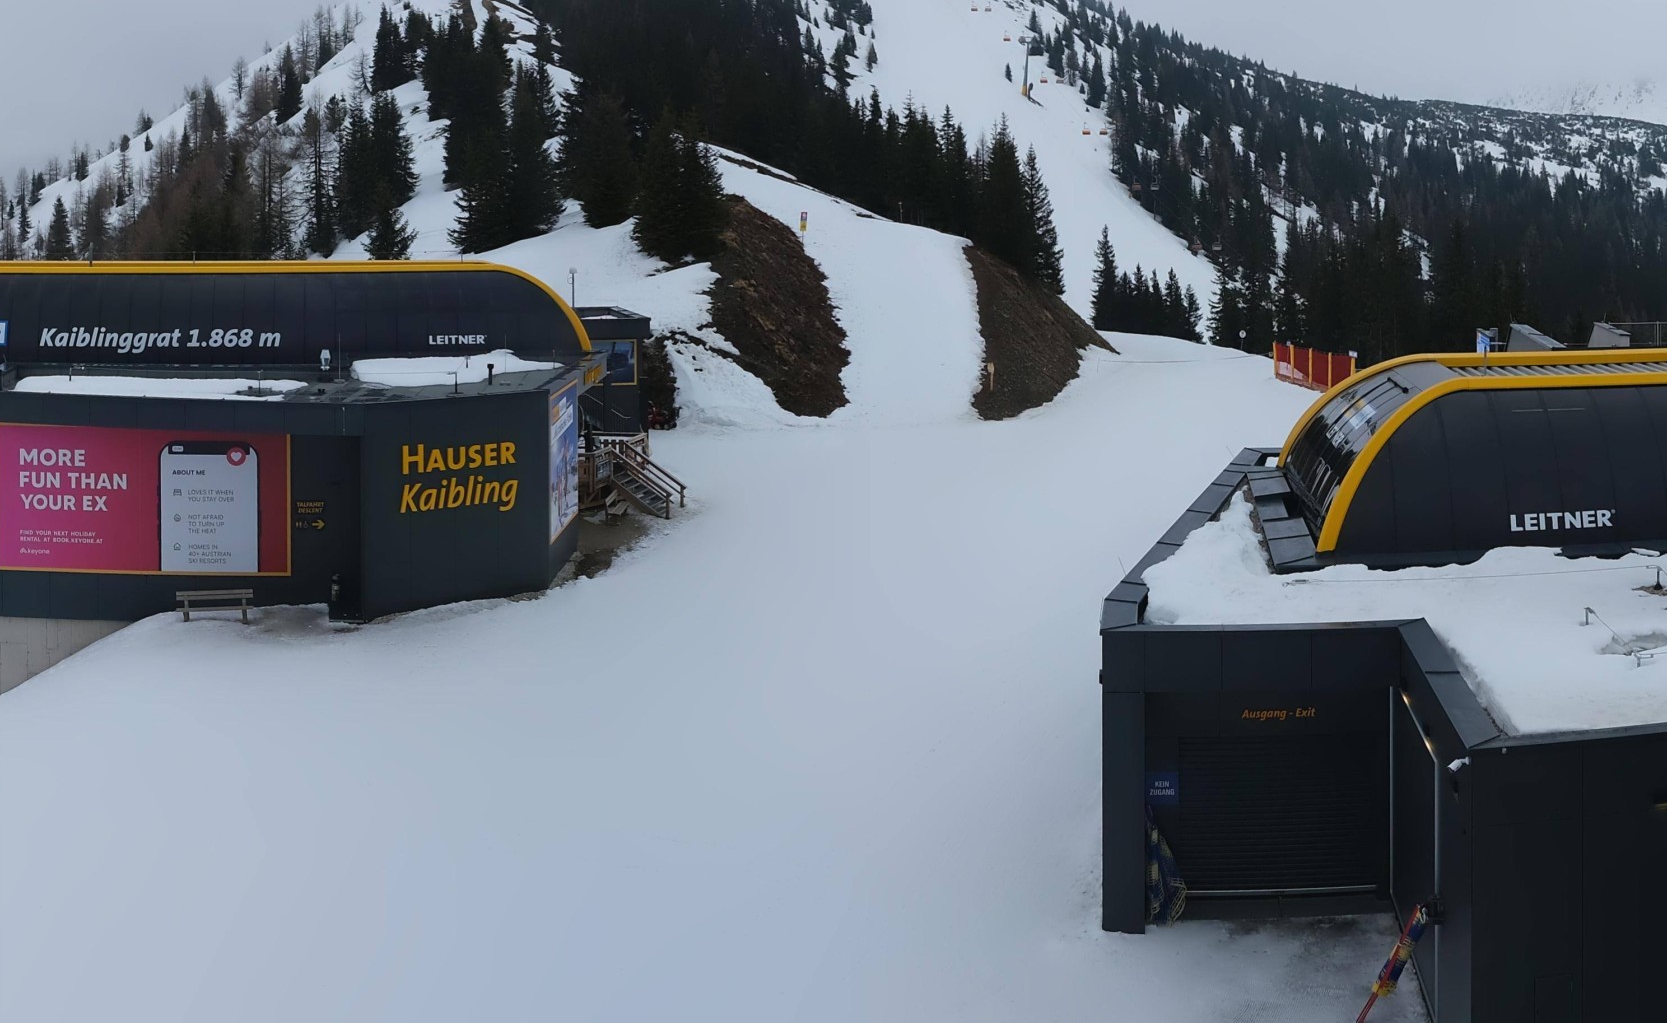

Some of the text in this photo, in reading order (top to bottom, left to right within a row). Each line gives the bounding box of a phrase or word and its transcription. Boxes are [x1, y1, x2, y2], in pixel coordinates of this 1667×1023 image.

[39, 326, 281, 354] Kaiblinggrat 1.868 m
[428, 334, 486, 345] LEITNER
[19, 448, 86, 466] MORE
[402, 441, 516, 475] HAUSER
[19, 471, 128, 490] FUN THAN
[20, 494, 108, 512] YOUR EX
[400, 475, 519, 514] Kaibling
[1509, 509, 1613, 532] LEITNER
[1241, 708, 1287, 721] Ausgang
[1295, 707, 1316, 718] Exit
[1149, 788, 1175, 796] ZUGANG
[1154, 780, 1170, 788] KEIN
